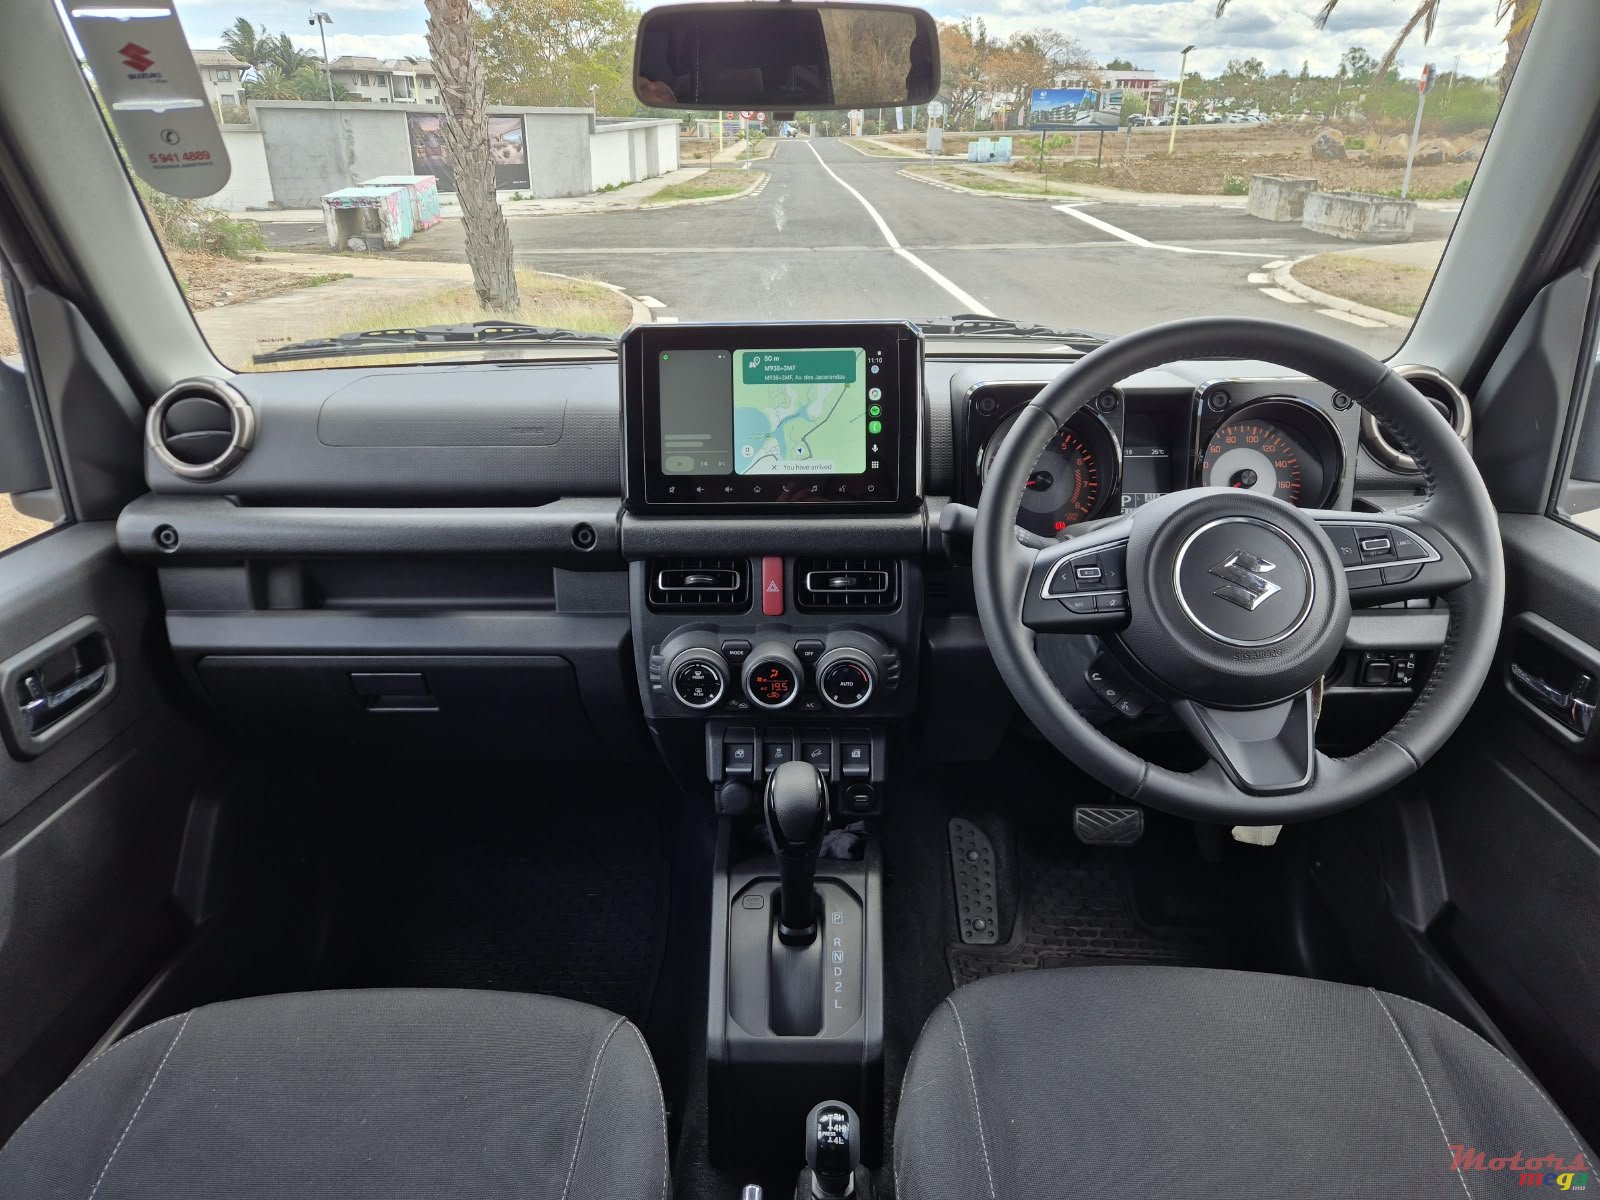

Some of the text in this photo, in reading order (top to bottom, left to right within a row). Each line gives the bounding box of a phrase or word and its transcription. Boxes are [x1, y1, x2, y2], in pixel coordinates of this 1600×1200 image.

[149, 153, 158, 163] 5
[159, 152, 180, 163] 941
[1225, 436, 1237, 444] 80
[1246, 435, 1259, 444] 100
[1210, 445, 1221, 453] 60
[1262, 445, 1276, 453] 120
[1275, 460, 1288, 468] 140
[1278, 481, 1291, 489] 160
[1121, 495, 1132, 508] P
[833, 913, 841, 922] P
[833, 937, 842, 947] R
[834, 952, 842, 961] N
[834, 966, 842, 977] D
[834, 981, 843, 992] 2
[834, 999, 843, 1009] L
